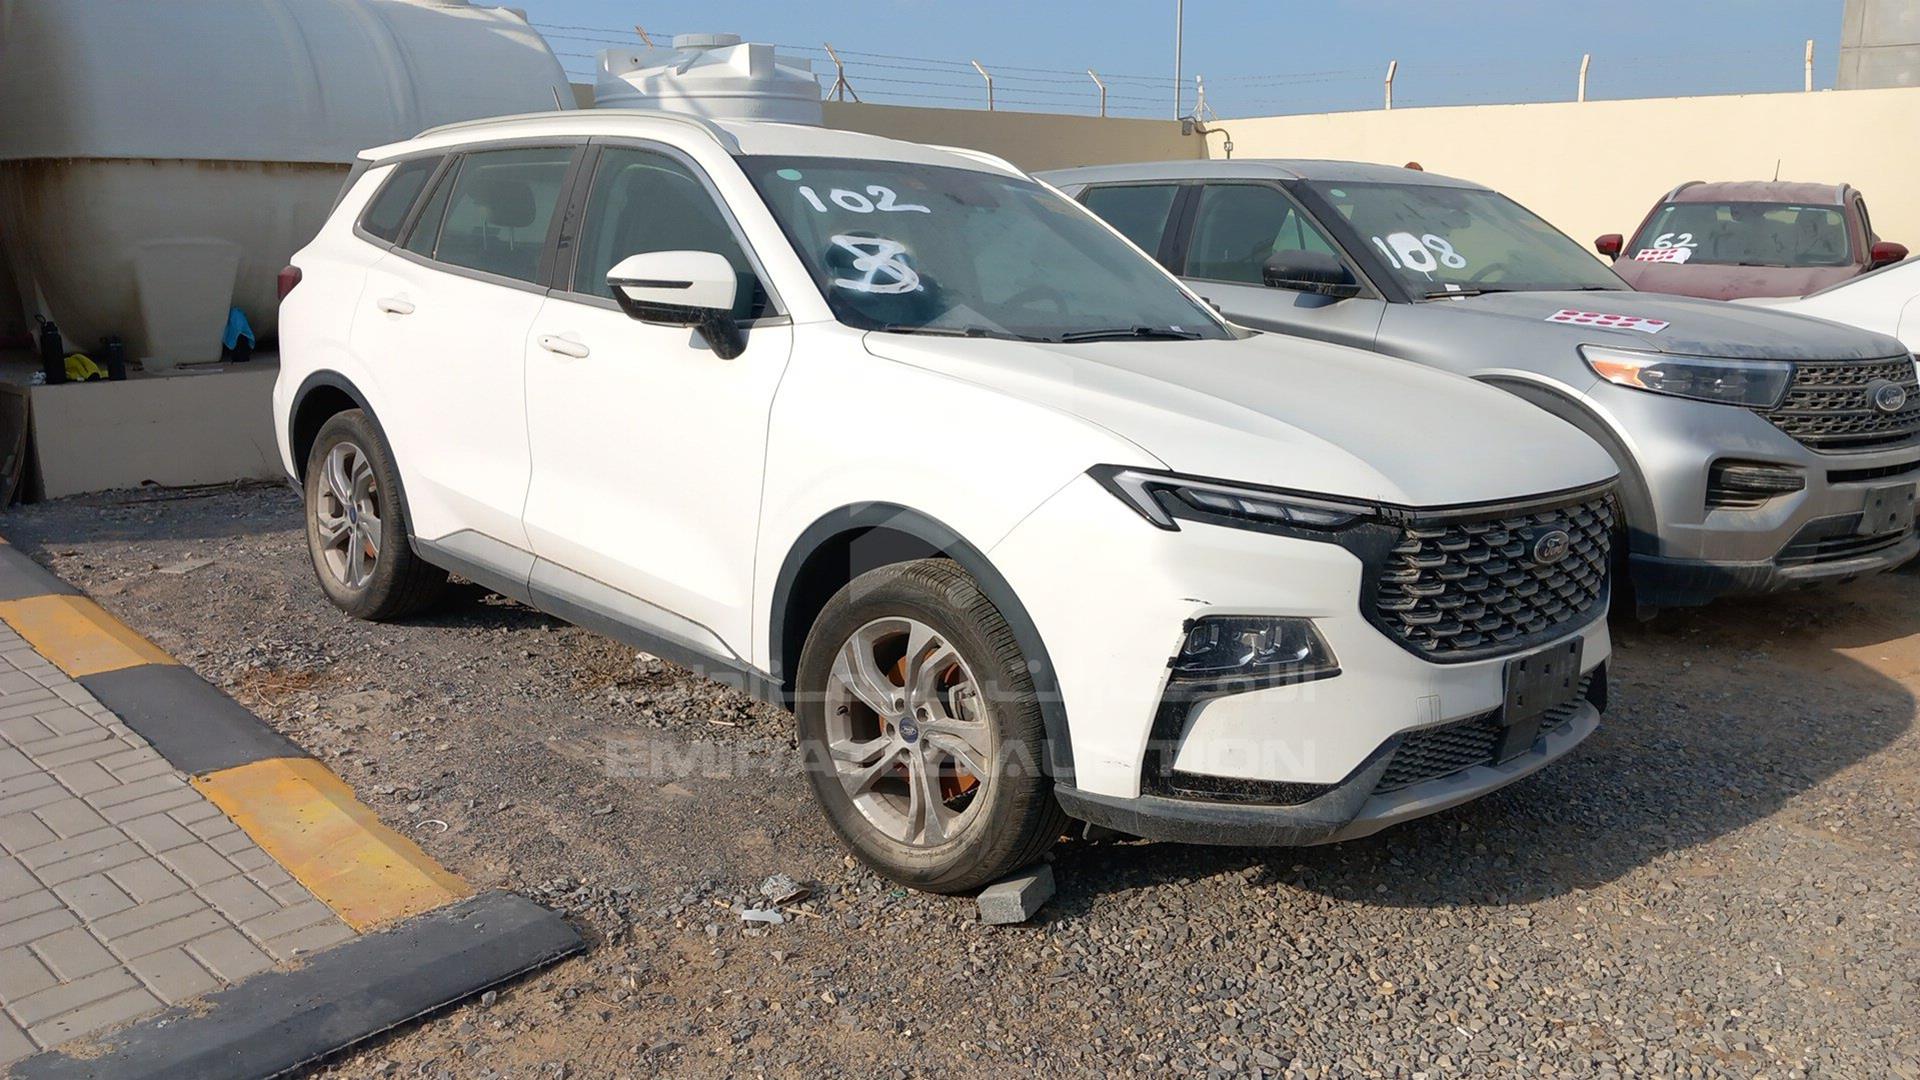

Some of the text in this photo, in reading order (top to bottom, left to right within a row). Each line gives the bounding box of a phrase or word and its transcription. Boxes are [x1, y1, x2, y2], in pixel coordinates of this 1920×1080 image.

[799, 185, 932, 213] 102
[1371, 232, 1467, 273] 108
[1653, 232, 1699, 250] 62
